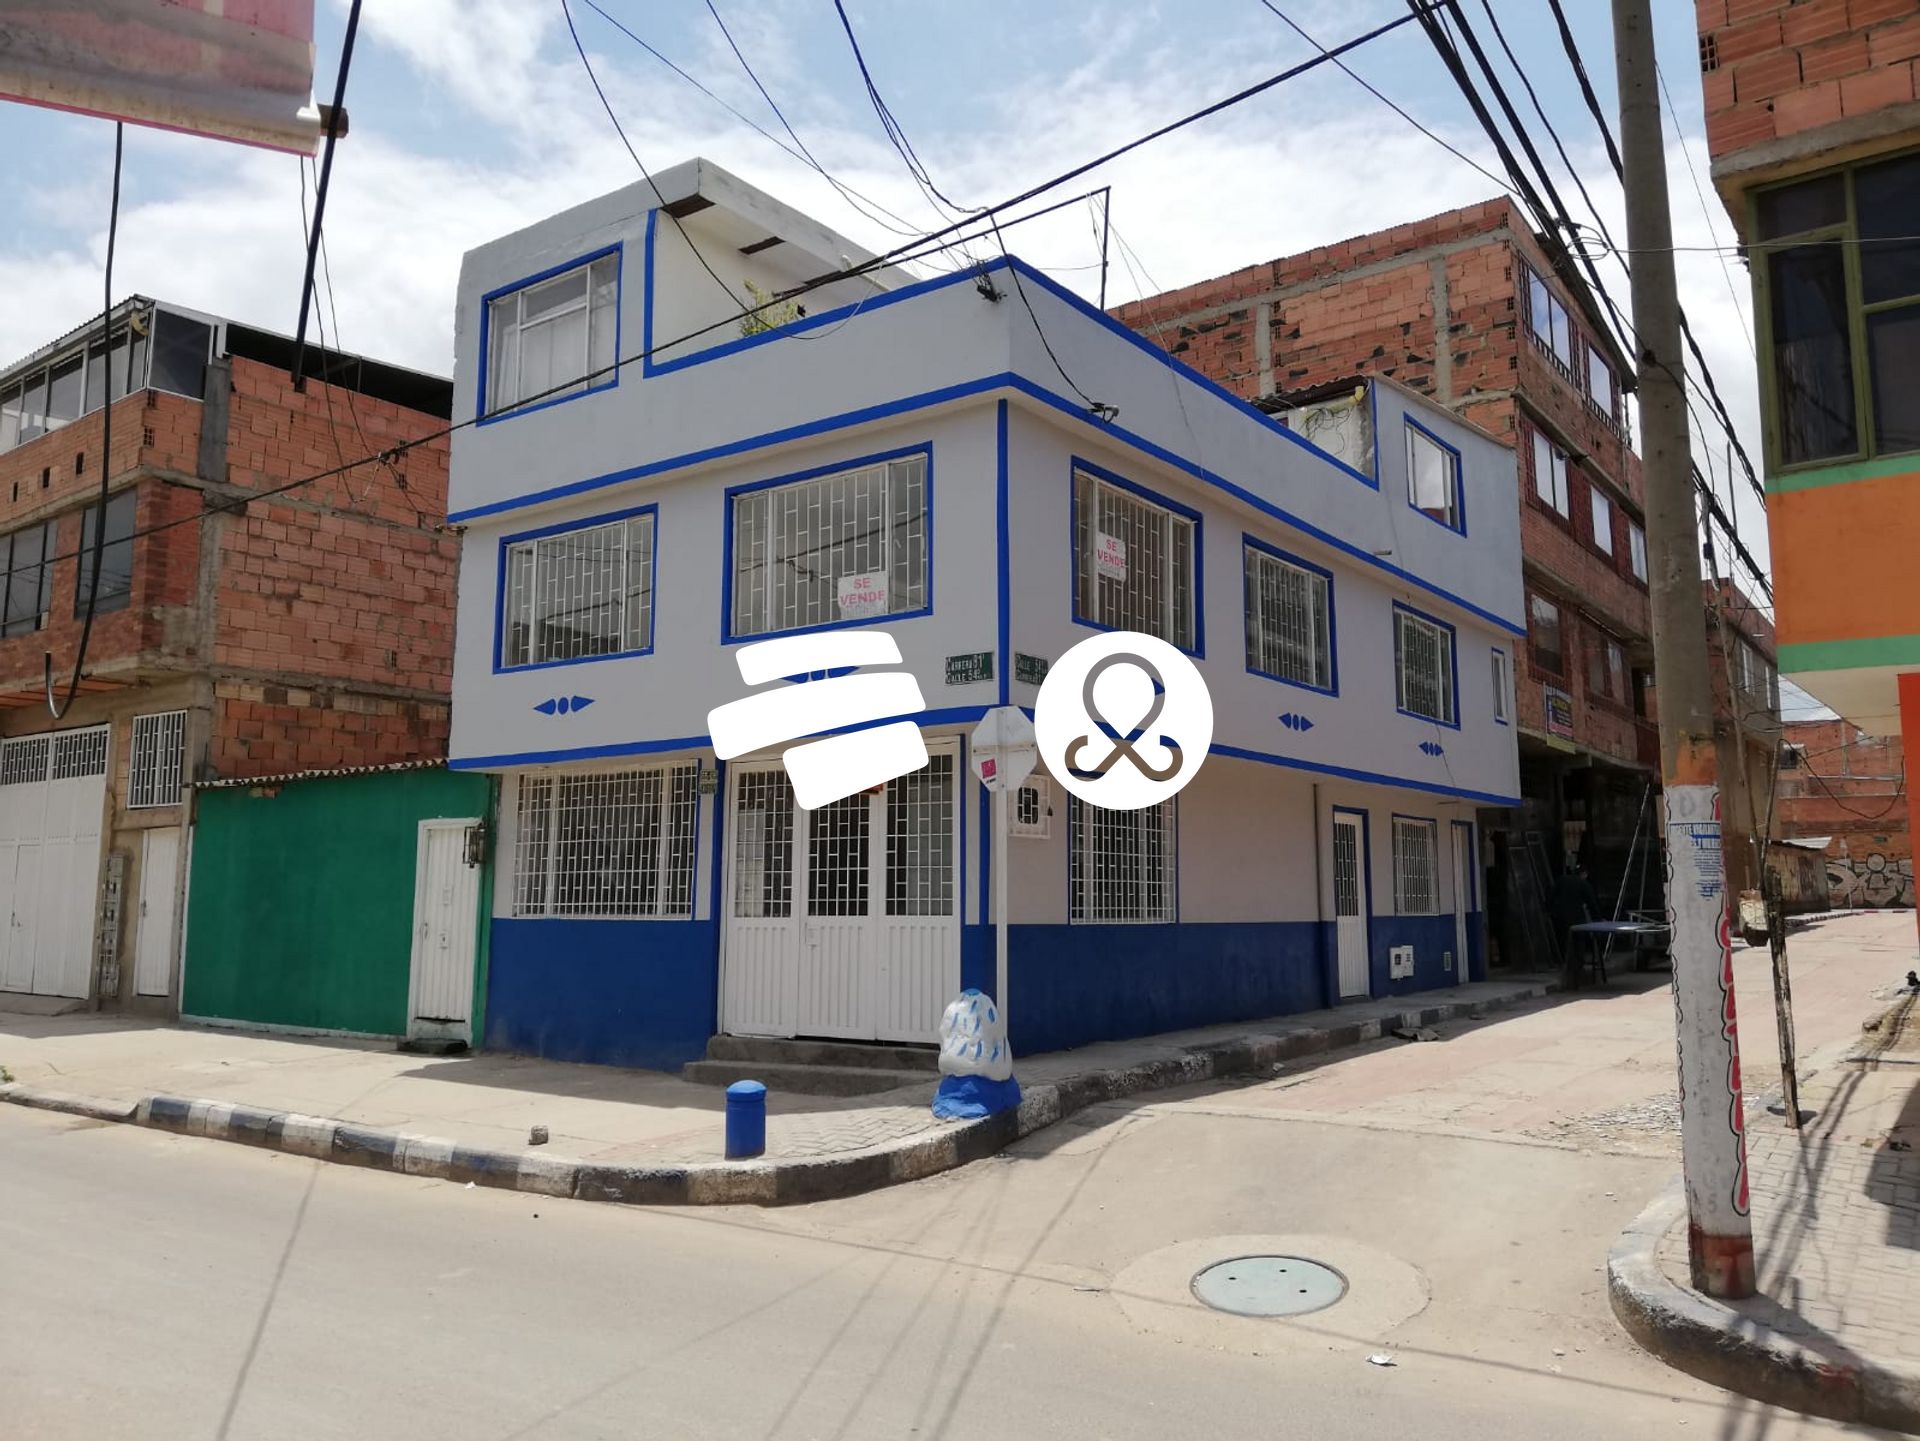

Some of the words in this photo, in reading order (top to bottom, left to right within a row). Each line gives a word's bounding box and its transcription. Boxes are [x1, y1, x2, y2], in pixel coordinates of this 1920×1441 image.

[1105, 539, 1117, 551] SE
[1097, 548, 1125, 568] VENDE
[853, 577, 872, 589] SE
